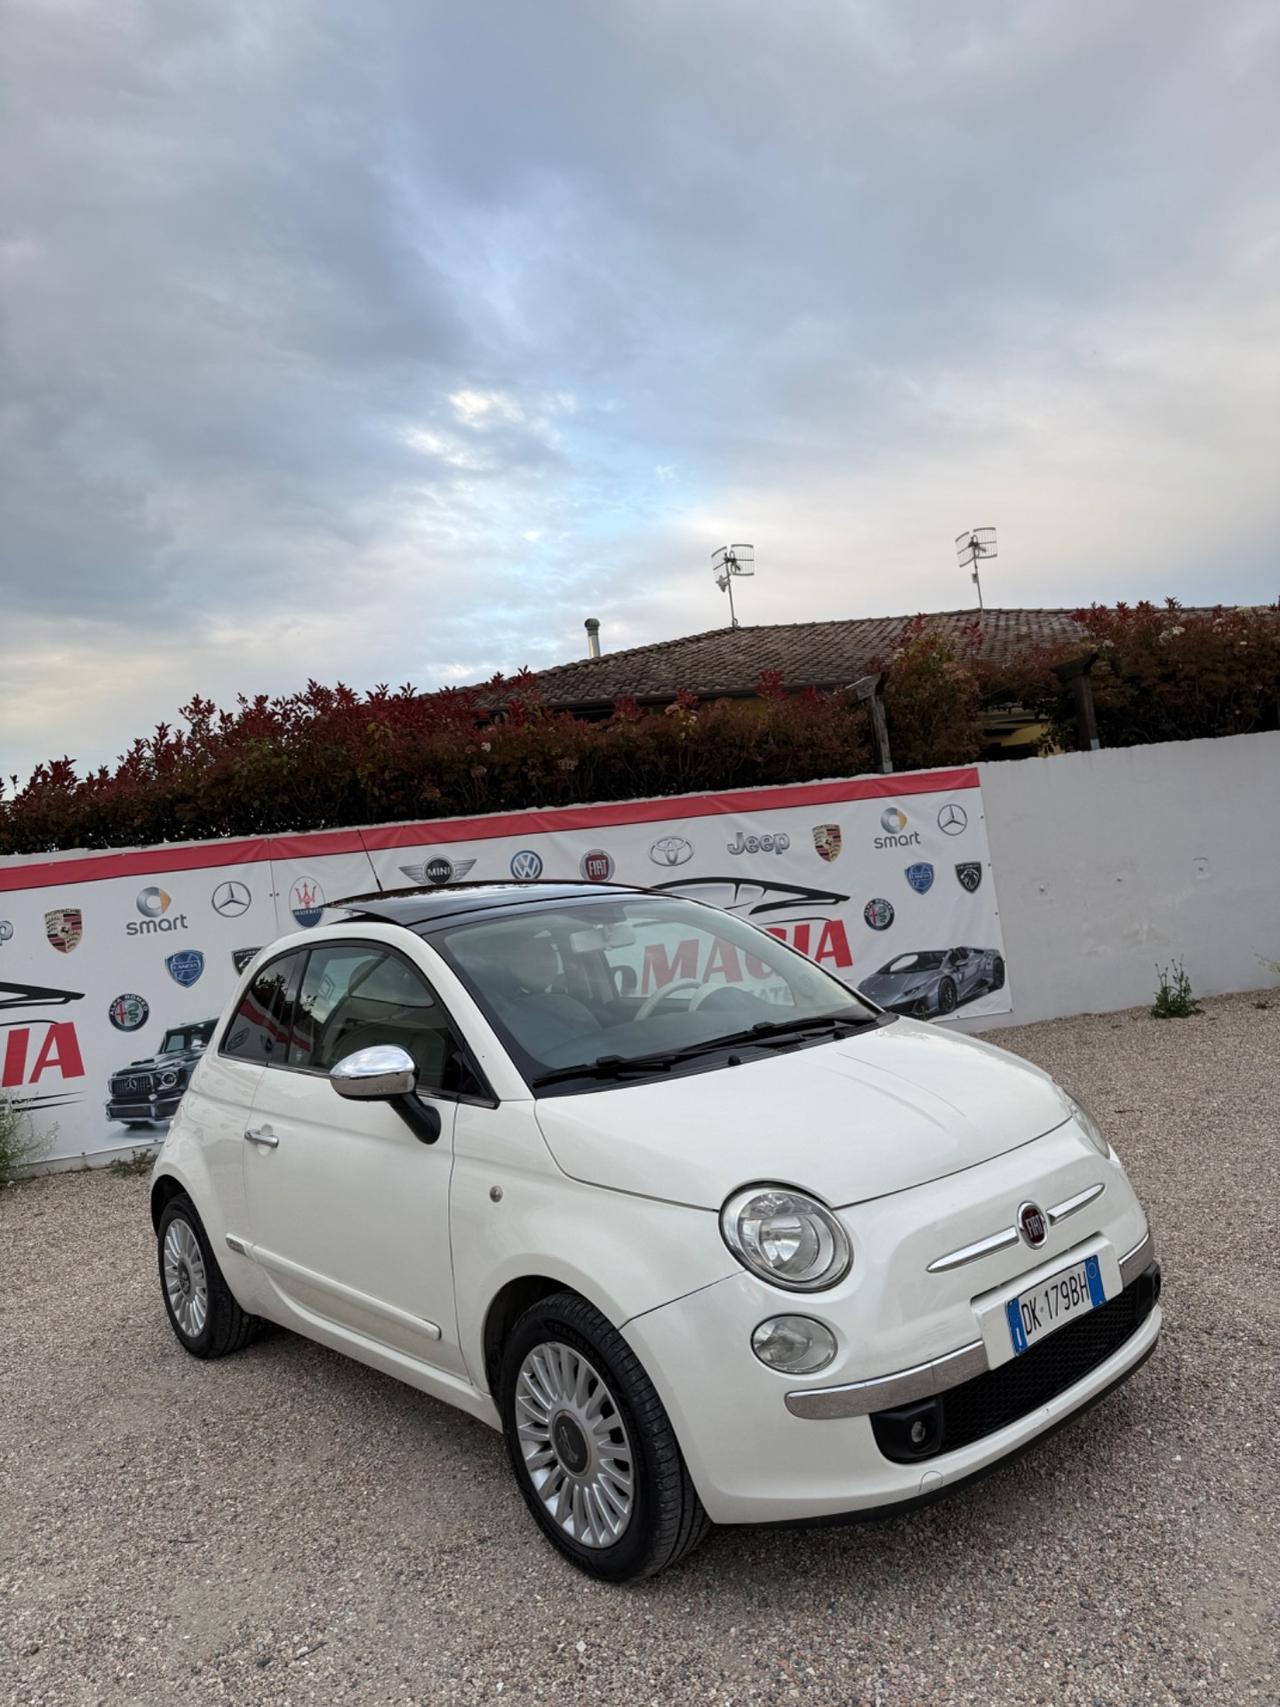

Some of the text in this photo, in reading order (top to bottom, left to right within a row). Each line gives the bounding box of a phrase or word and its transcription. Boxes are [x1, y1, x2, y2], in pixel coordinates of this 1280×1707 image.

[727, 832, 791, 855] Jeep
[873, 831, 921, 849] smart
[427, 866, 451, 877] MINI
[588, 859, 607, 876] FIAT
[126, 913, 188, 936] smart
[1025, 1215, 1043, 1240] FIAT
[1020, 1295, 1043, 1335] DK
